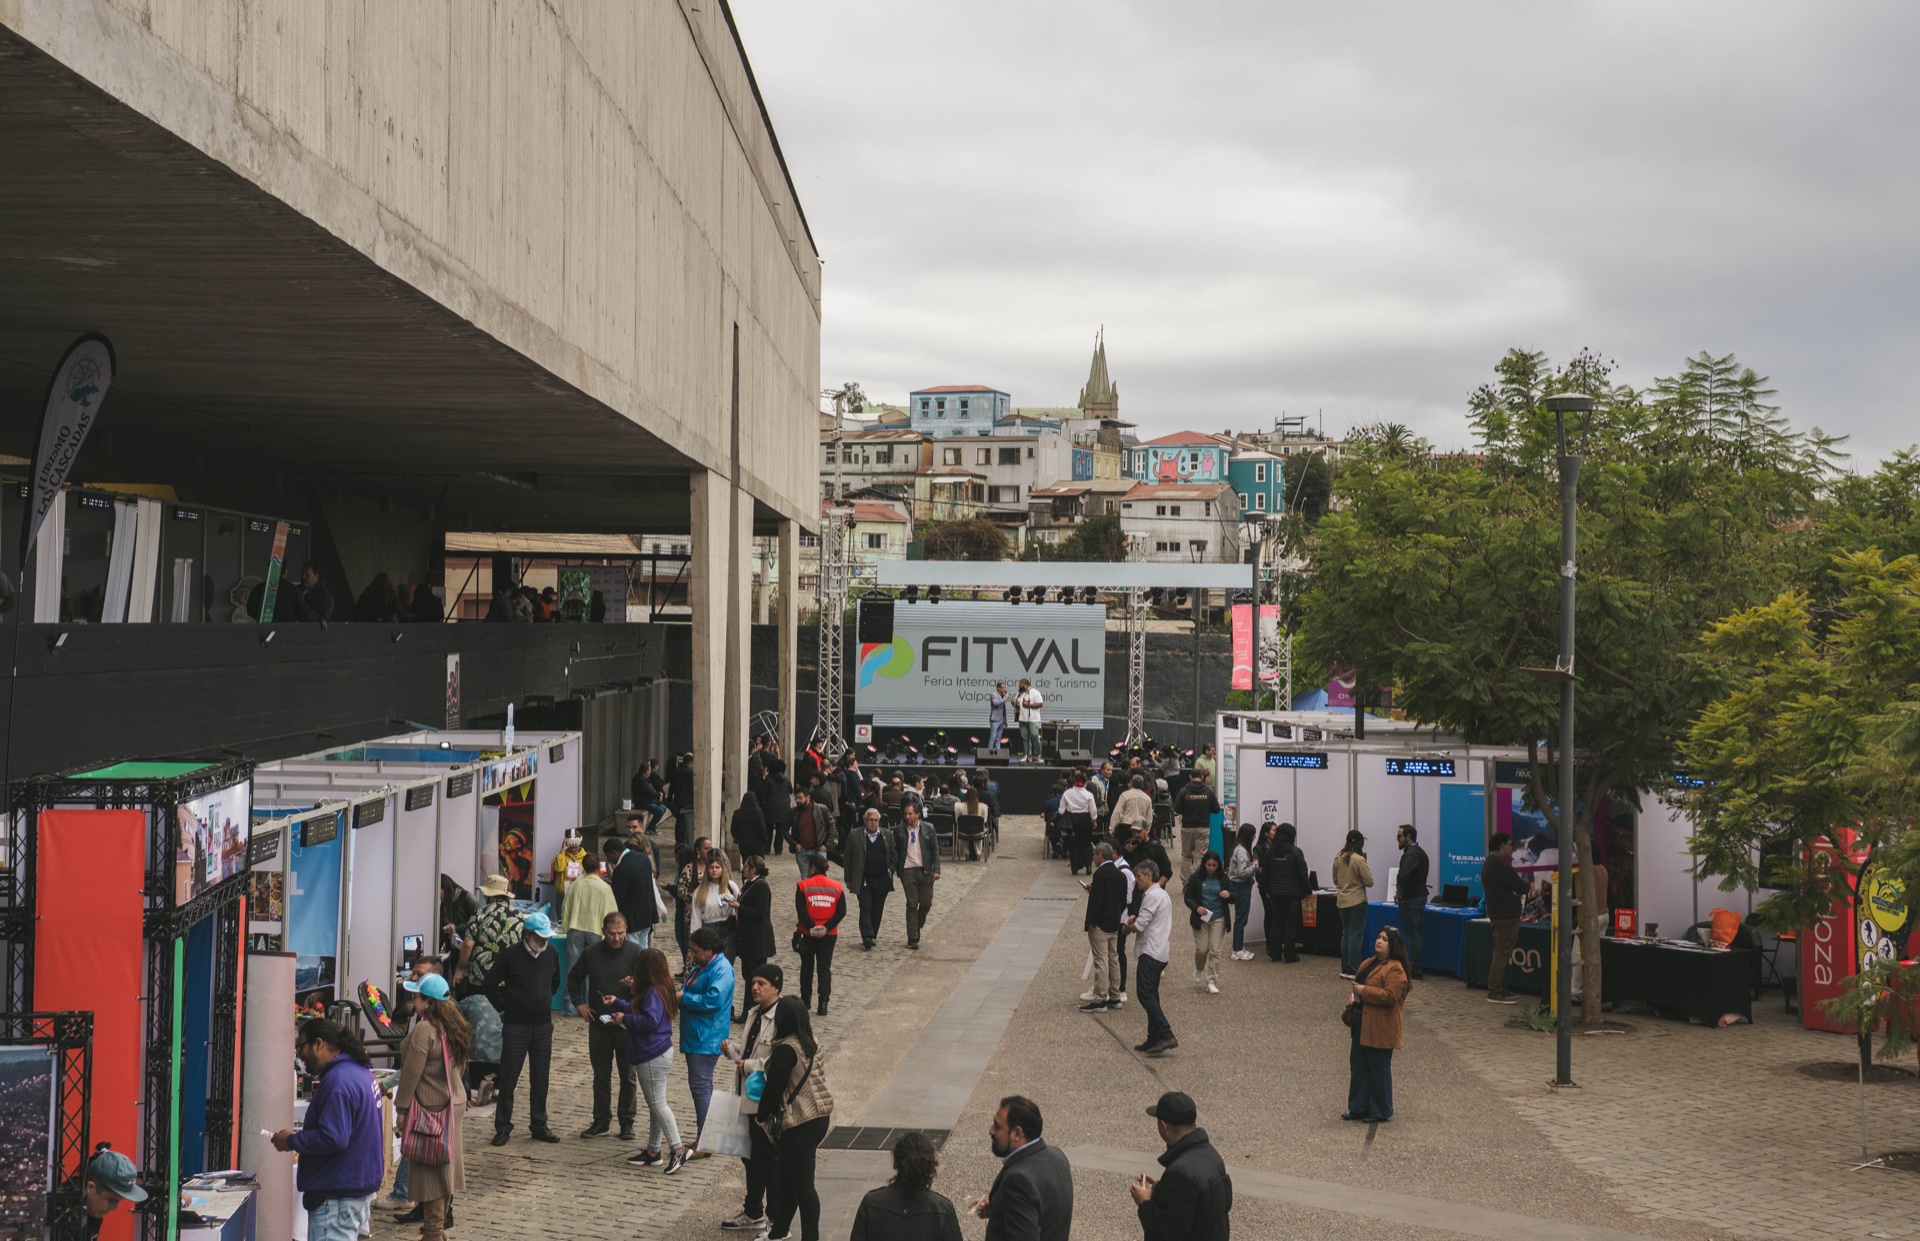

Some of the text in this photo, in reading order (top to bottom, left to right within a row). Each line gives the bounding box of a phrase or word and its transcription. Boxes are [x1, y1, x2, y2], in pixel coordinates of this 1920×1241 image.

[37, 425, 71, 490] TURISMO
[38, 487, 54, 516] LAS
[49, 413, 90, 487] CASCADAS
[921, 636, 1100, 674] FITVAL
[924, 676, 1098, 689] Feria Internaionl de Turismo
[959, 690, 1017, 703] Valpaso
[1263, 805, 1277, 813] ATA
[809, 895, 836, 903] SEGURIDAD
